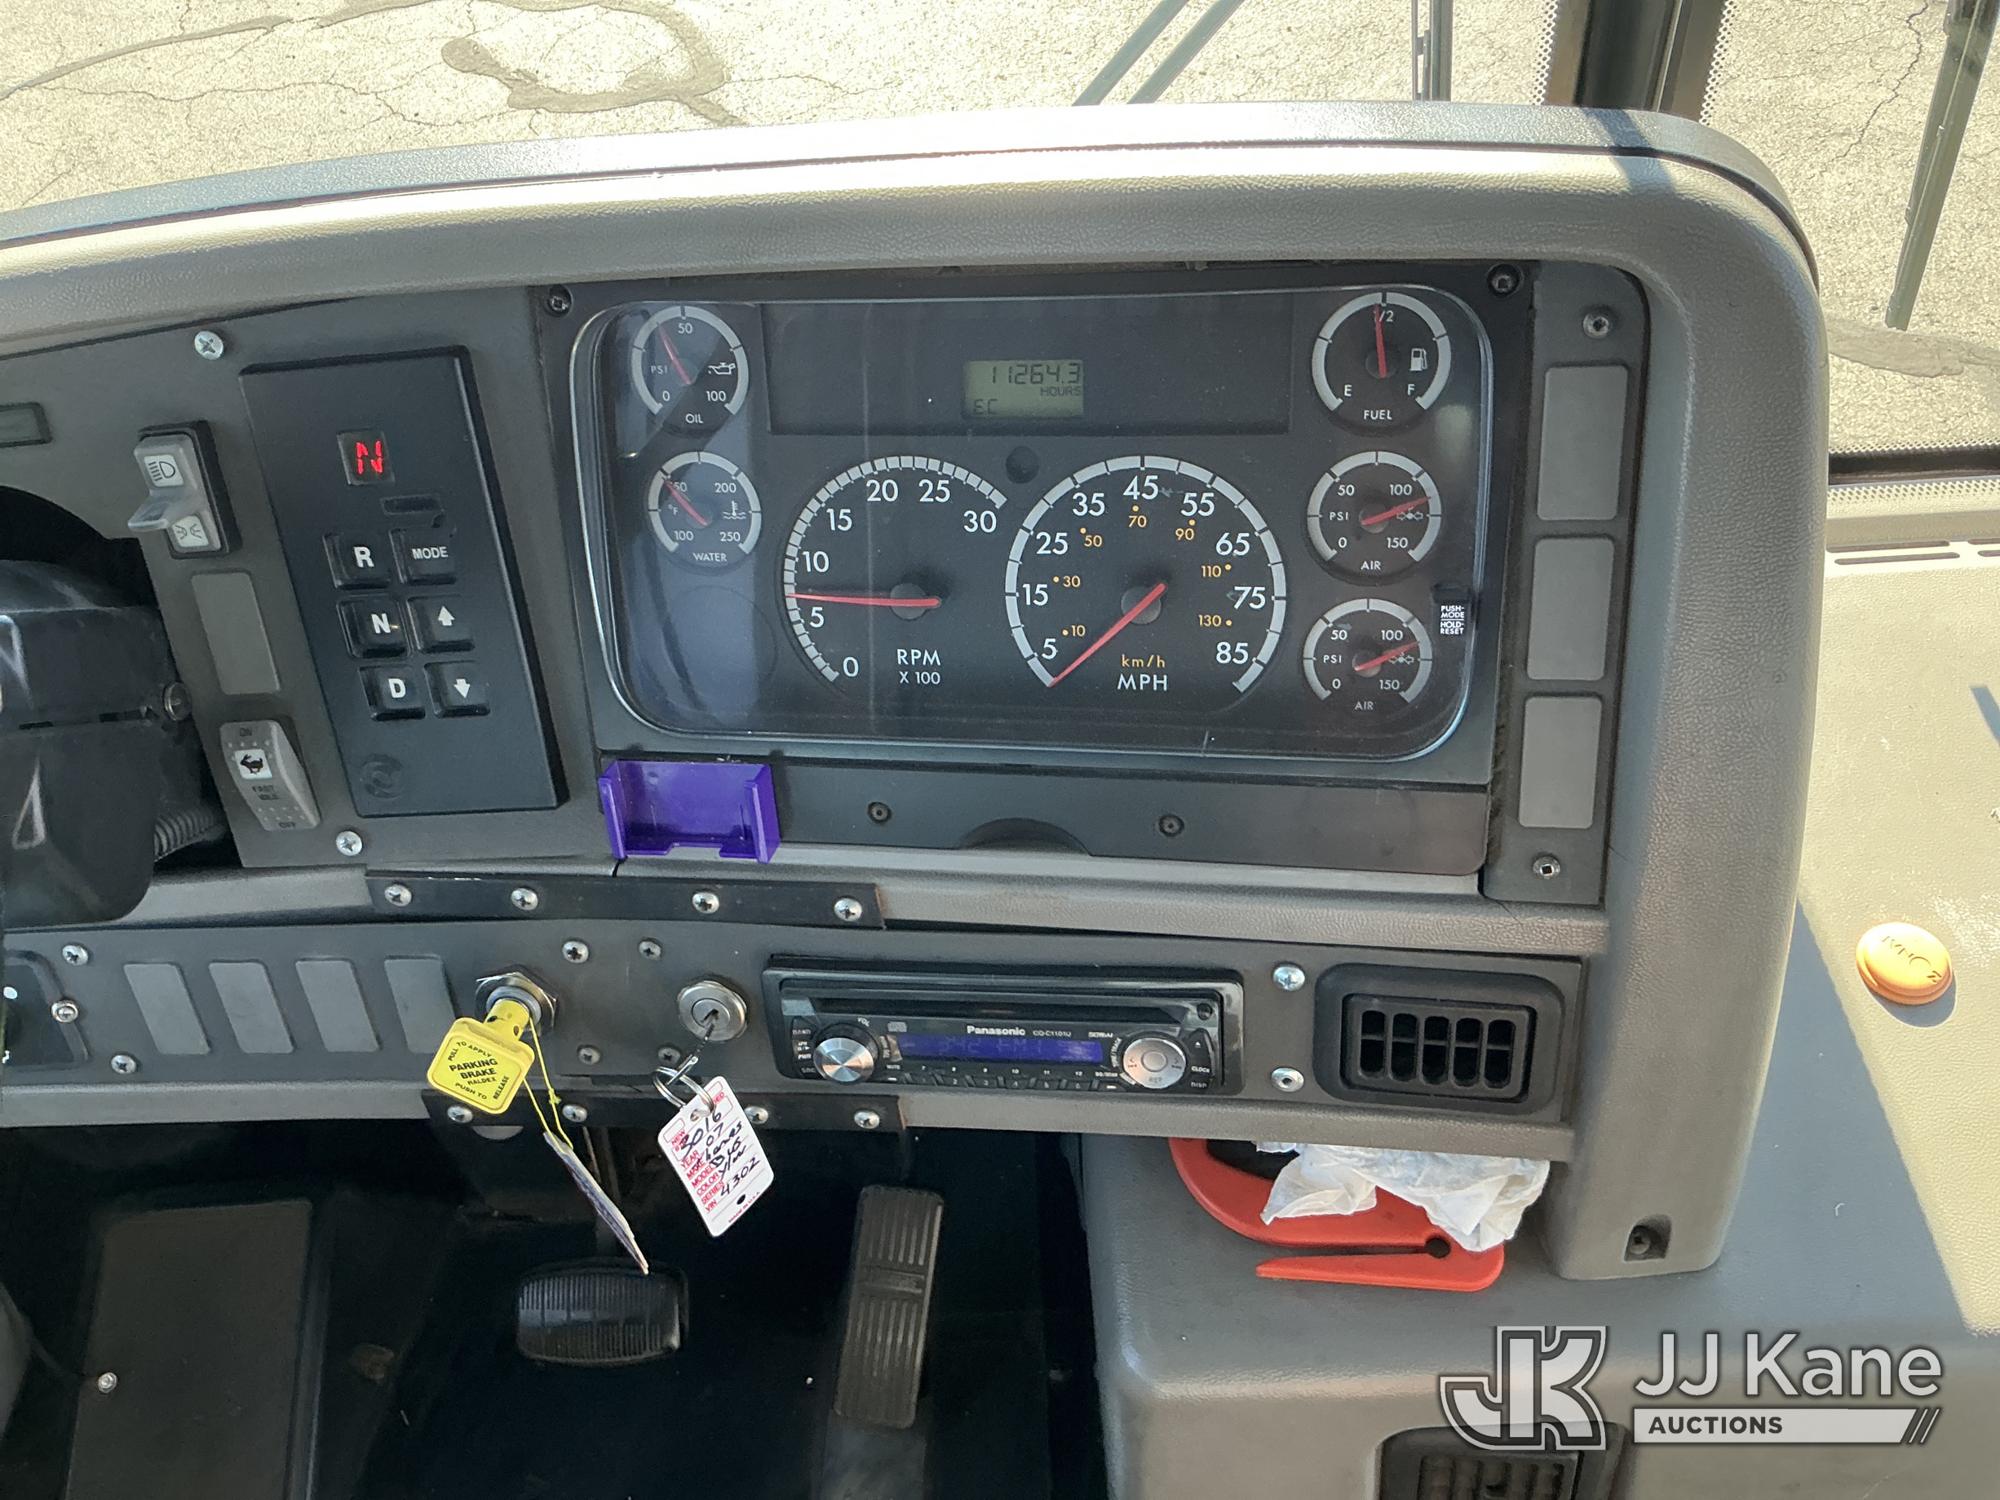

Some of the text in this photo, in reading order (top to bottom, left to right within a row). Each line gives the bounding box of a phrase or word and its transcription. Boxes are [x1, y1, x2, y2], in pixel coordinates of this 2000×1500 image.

[677, 323, 693, 334] 50
[651, 365, 668, 375] PSI
[992, 362, 1081, 385] 11264.3
[1040, 386, 1081, 397] HOURS
[1344, 384, 1352, 397] E
[1407, 383, 1415, 396] F
[661, 391, 671, 402] 0
[706, 391, 727, 402] 100
[685, 413, 703, 424] OIL
[1363, 410, 1393, 420] FUEL
[355, 440, 384, 475] N
[714, 482, 737, 493] 200
[865, 479, 899, 502] 20
[918, 480, 951, 502] 25
[1123, 475, 1159, 499] 45
[1337, 484, 1355, 496] 50
[1389, 484, 1412, 496] 100
[1072, 493, 1106, 516] 35
[1180, 492, 1216, 517] 55
[826, 509, 853, 532] 15
[963, 510, 997, 533] 30
[1128, 516, 1147, 528] 70
[1329, 511, 1349, 521] PSI
[674, 530, 694, 542] 100
[719, 531, 741, 542] 250
[1084, 535, 1103, 547] 50
[1175, 529, 1195, 541] 90
[1036, 532, 1068, 555] 25
[1215, 532, 1251, 556] 65
[1338, 537, 1347, 548] 0
[1386, 537, 1409, 549] 150
[353, 546, 375, 568] R
[412, 546, 448, 560] MODE
[693, 552, 727, 562] WATER
[802, 551, 829, 573] 10
[1361, 561, 1382, 571] AIR
[1201, 565, 1222, 578] 110
[1063, 575, 1081, 588] 30
[1022, 584, 1049, 606] 15
[1233, 586, 1266, 610] 75
[371, 613, 391, 634] N
[809, 607, 824, 628] 5
[1198, 615, 1222, 627] 130
[1071, 625, 1086, 637] 10
[1331, 629, 1348, 641] 50
[1381, 629, 1403, 641] 100
[1440, 627, 1464, 635] RESET
[1042, 638, 1057, 660] 5
[1215, 641, 1249, 664] 85
[897, 649, 941, 666] RPM
[1121, 654, 1165, 668] km/h
[1323, 655, 1342, 664] PSI
[843, 657, 859, 677] 0
[900, 672, 941, 685] X 100
[1117, 674, 1168, 691] MPH
[1332, 678, 1341, 690] 0
[1379, 679, 1400, 690] 150
[388, 678, 406, 699] D
[1354, 701, 1374, 711] AIR
[967, 1025, 1026, 1036] Panasonic
[448, 1048, 459, 1061] PULL
[468, 1045, 492, 1057] APPLY
[449, 1058, 498, 1071] PARKING
[460, 1068, 497, 1079] BRAKE
[455, 1075, 509, 1100] PUSH TO RELEASE
[681, 1150, 700, 1168] YEAR
[692, 1162, 715, 1188] MODEL
[721, 1157, 760, 1196] 4302
[697, 1172, 719, 1195] COLOR
[701, 1180, 724, 1204] SERIES
[705, 1199, 718, 1212] VIN
